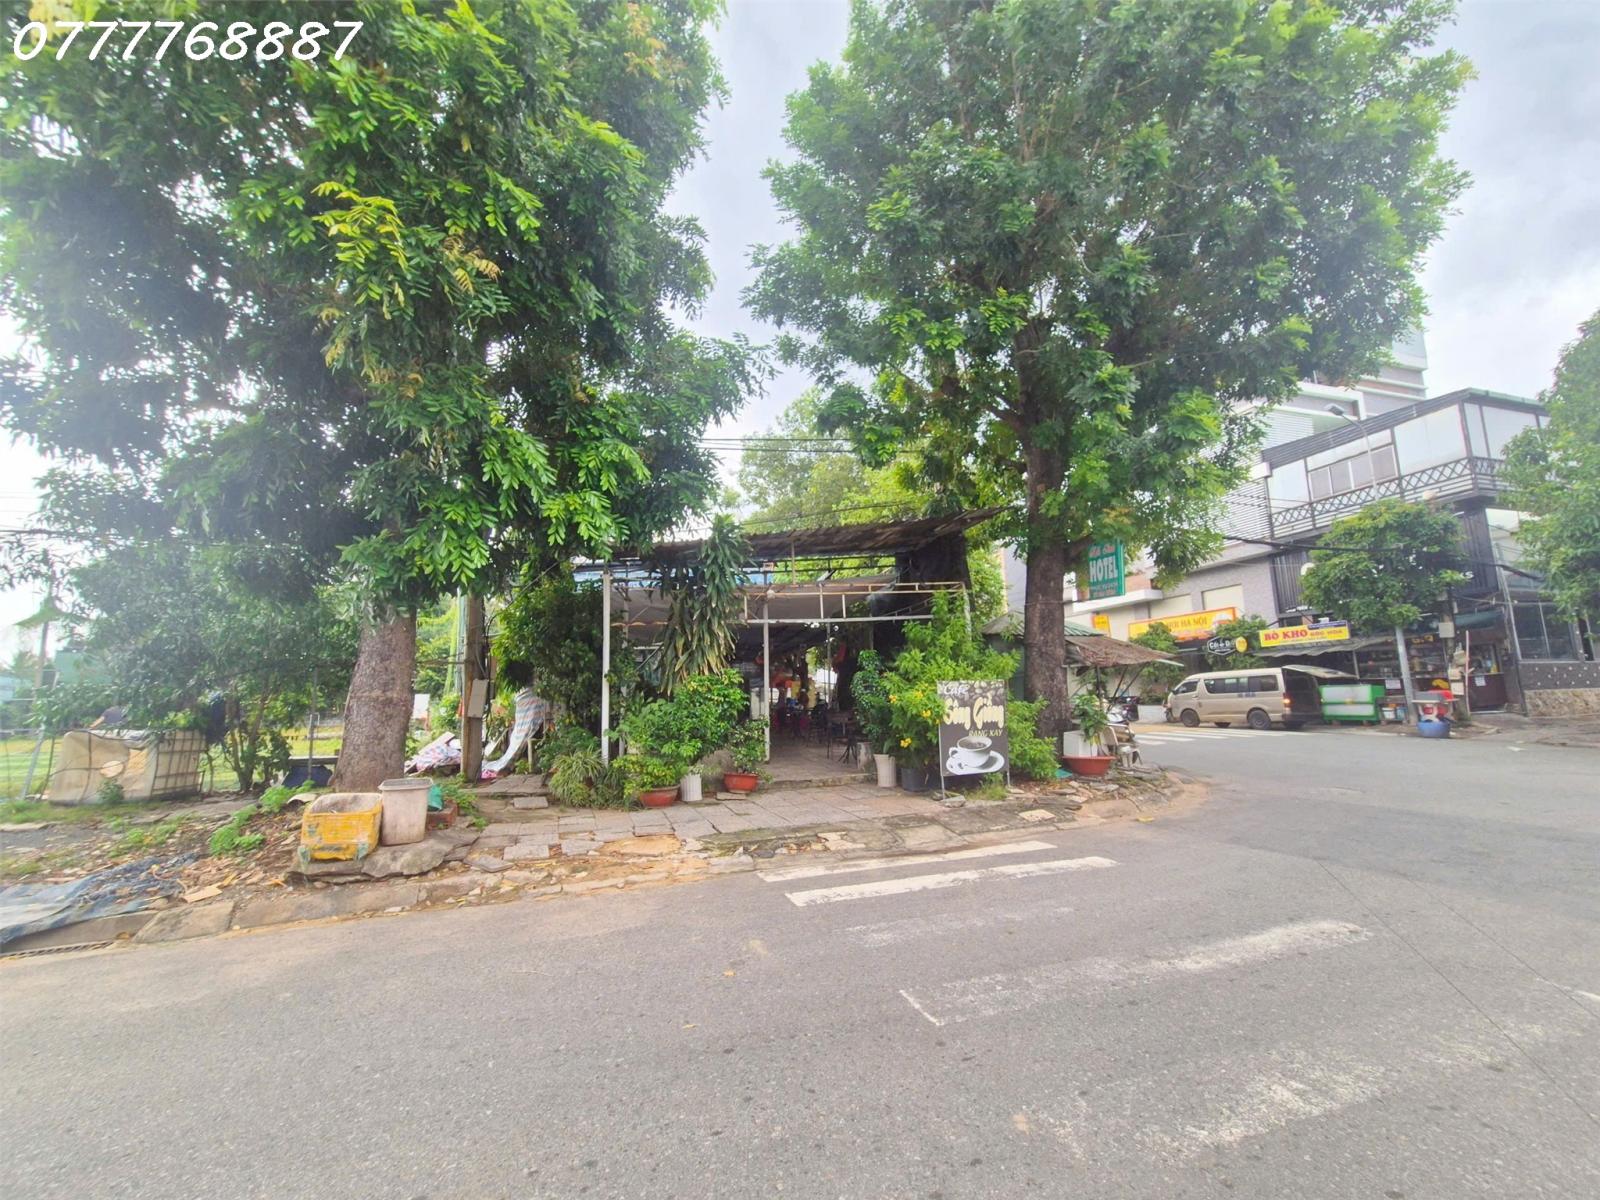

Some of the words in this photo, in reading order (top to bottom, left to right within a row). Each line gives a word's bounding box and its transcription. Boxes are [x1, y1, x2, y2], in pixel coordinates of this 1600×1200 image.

[1089, 555, 1118, 582] HOTEL
[1264, 630, 1279, 641] BÒ
[1282, 629, 1308, 640] KHO
[989, 729, 1003, 737] XAY
